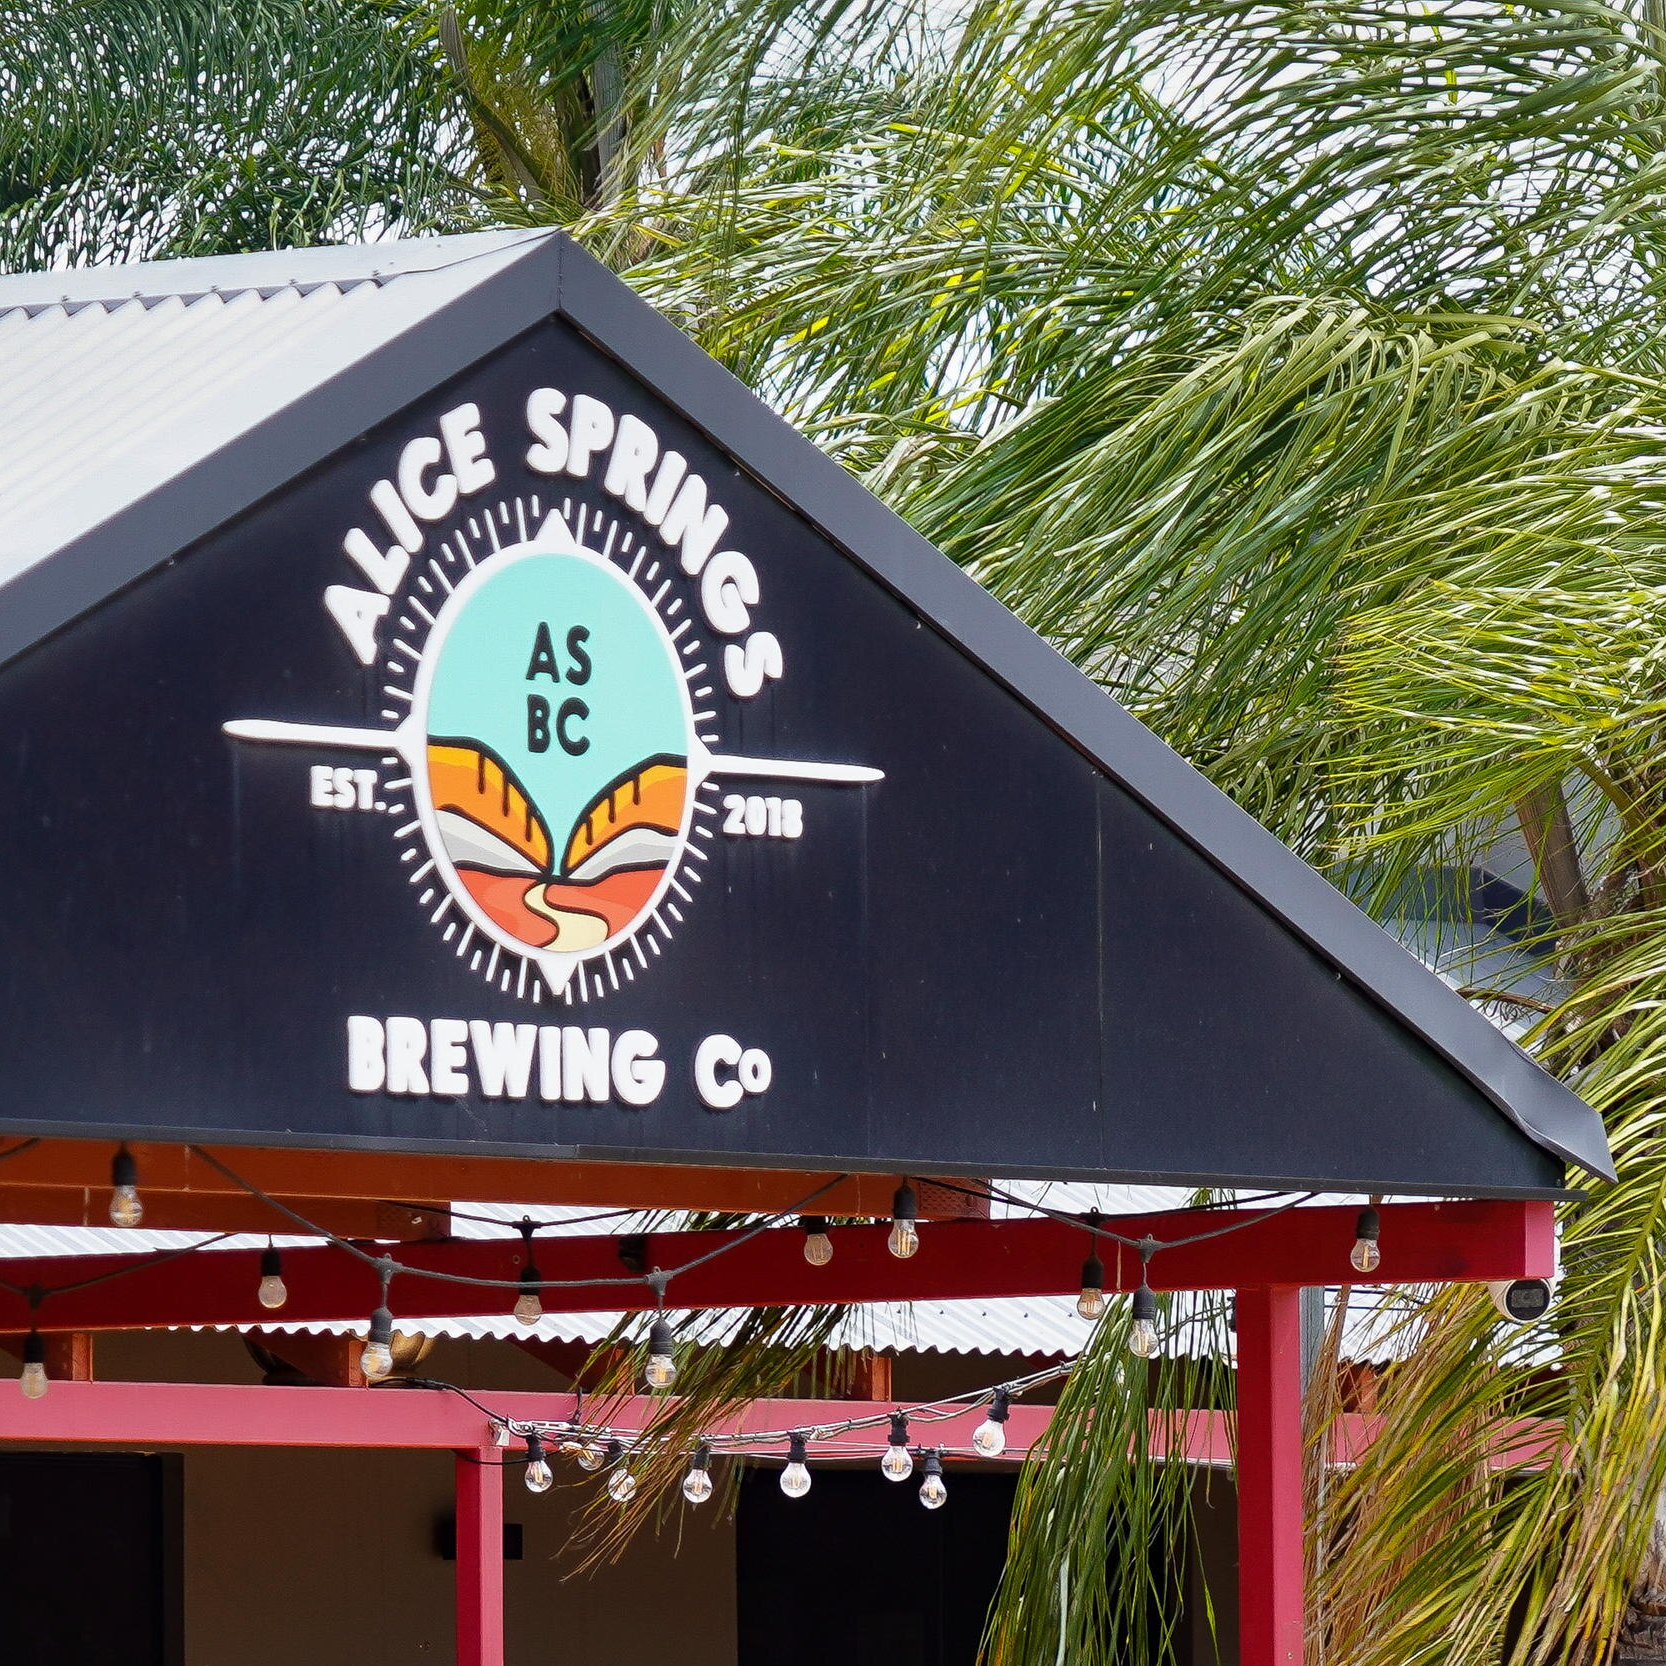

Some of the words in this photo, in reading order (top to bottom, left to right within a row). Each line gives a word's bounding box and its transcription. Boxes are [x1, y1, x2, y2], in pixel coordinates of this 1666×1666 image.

[324, 402, 496, 666] ALICE
[525, 387, 784, 697] SPRINGS
[525, 621, 593, 686] AS
[526, 694, 591, 756] BC
[309, 765, 387, 813] EST.
[722, 794, 804, 839] 2018
[347, 1014, 667, 1106] BREWING
[694, 1033, 774, 1109] Co
